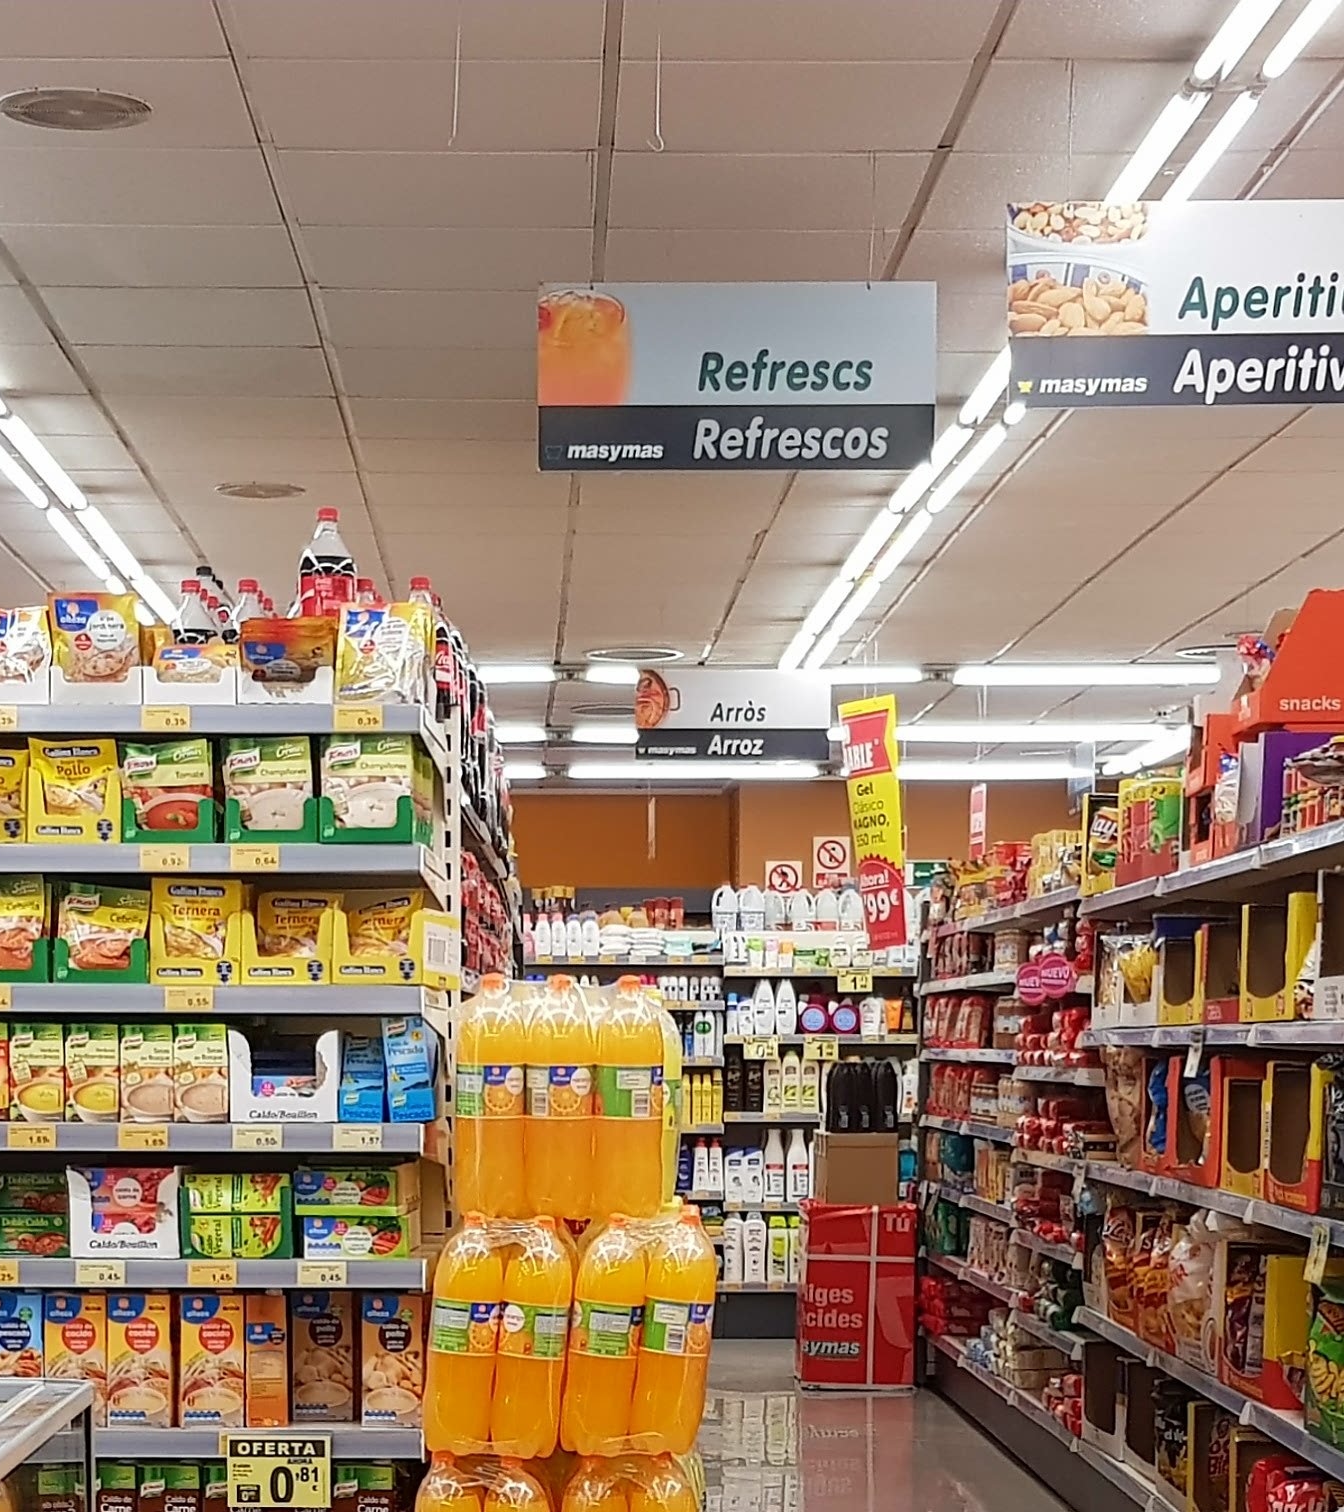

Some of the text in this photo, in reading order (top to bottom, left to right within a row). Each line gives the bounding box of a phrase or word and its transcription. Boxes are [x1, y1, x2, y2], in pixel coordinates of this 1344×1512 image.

[697, 347, 873, 394] Refrescs
[1039, 373, 1149, 398] masymas
[567, 416, 889, 464] masymas Refrescos
[710, 701, 767, 723] Arròs
[1279, 695, 1342, 712] snacks
[707, 734, 764, 756] Arroz
[56, 763, 92, 777] Pollo
[856, 782, 874, 797] Gel
[171, 902, 222, 918] Ternera
[883, 1212, 910, 1233] Tú
[237, 1442, 316, 1456] OFERTA
